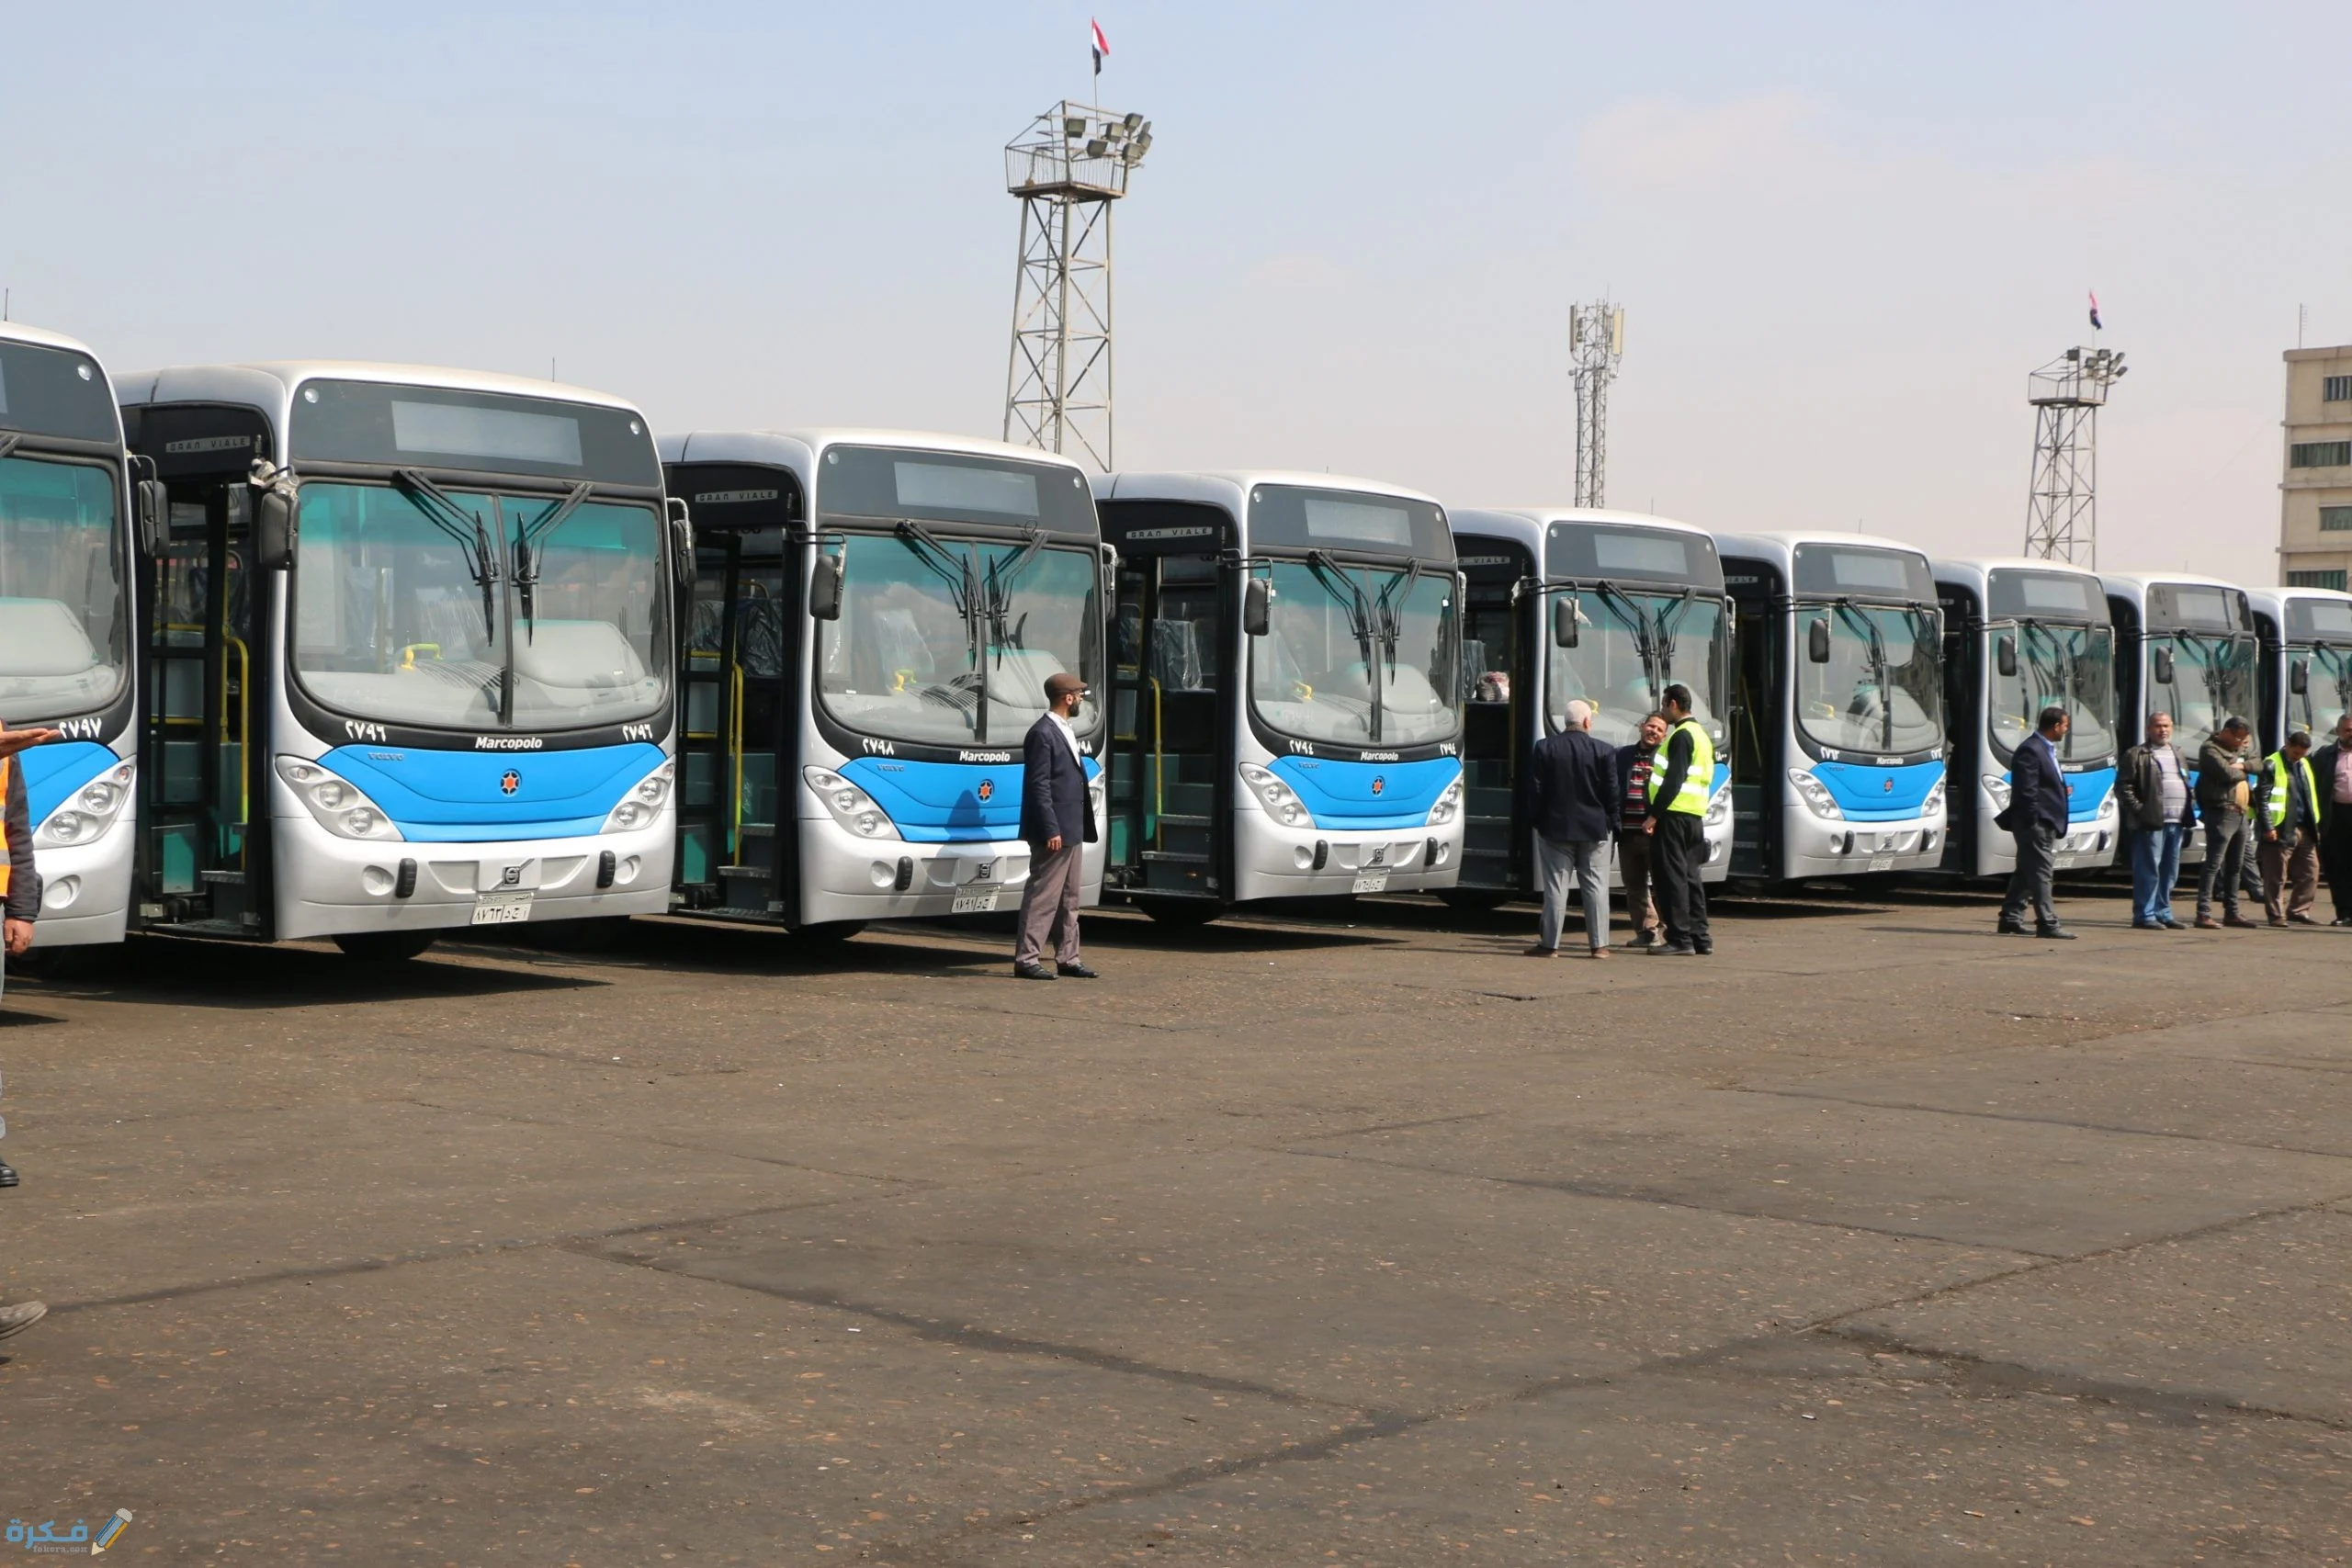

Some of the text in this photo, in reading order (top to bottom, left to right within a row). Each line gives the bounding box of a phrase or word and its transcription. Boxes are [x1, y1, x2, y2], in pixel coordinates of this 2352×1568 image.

[211, 438, 246, 448] VIALE
[739, 491, 774, 500] VIALE
[1171, 528, 1207, 536] VIALE
[59, 717, 102, 739] ٢٧٩٧
[345, 720, 387, 742] ٢٧٩٦
[622, 723, 653, 742] ٢٧٩٦
[474, 736, 543, 750] Marcopolo
[863, 738, 895, 756] ٢٧٩٨
[1289, 739, 1314, 755] ٢٧٩٤
[959, 750, 1011, 762] Marcopolo
[1360, 750, 1399, 761] Marcopolo
